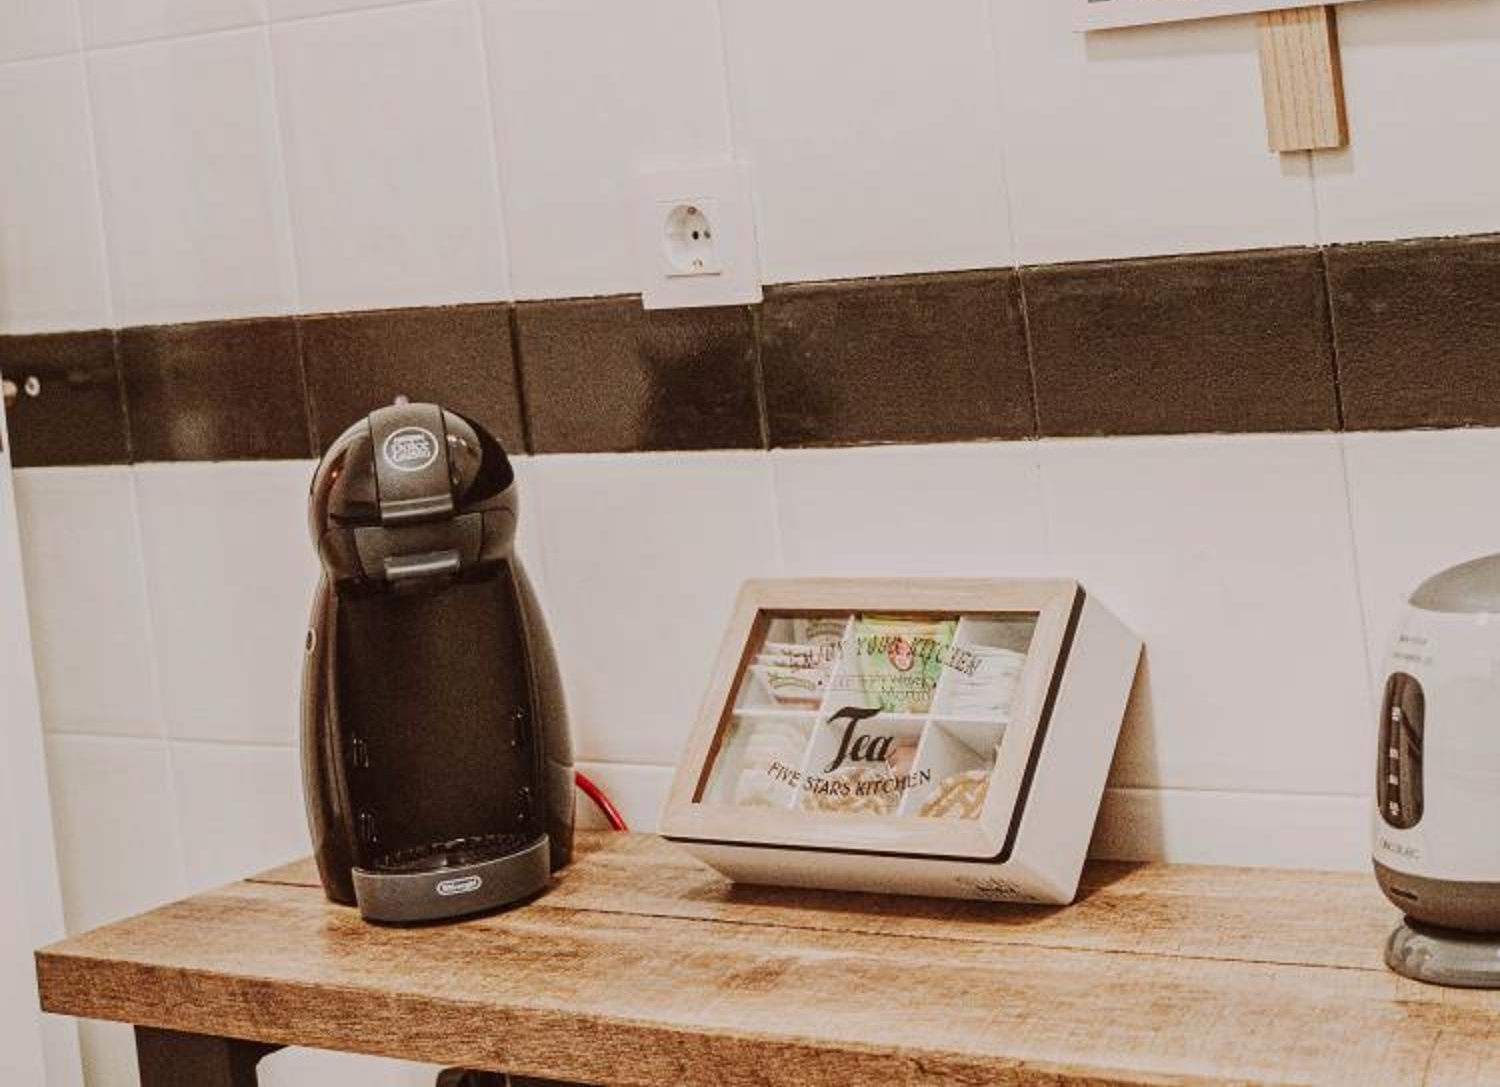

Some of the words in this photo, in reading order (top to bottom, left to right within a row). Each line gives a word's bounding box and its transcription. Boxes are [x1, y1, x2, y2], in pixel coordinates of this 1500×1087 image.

[824, 707, 896, 773] Tea
[768, 762, 802, 789] FIVE
[803, 776, 851, 796] STARS
[855, 768, 932, 796] KITCHEN
